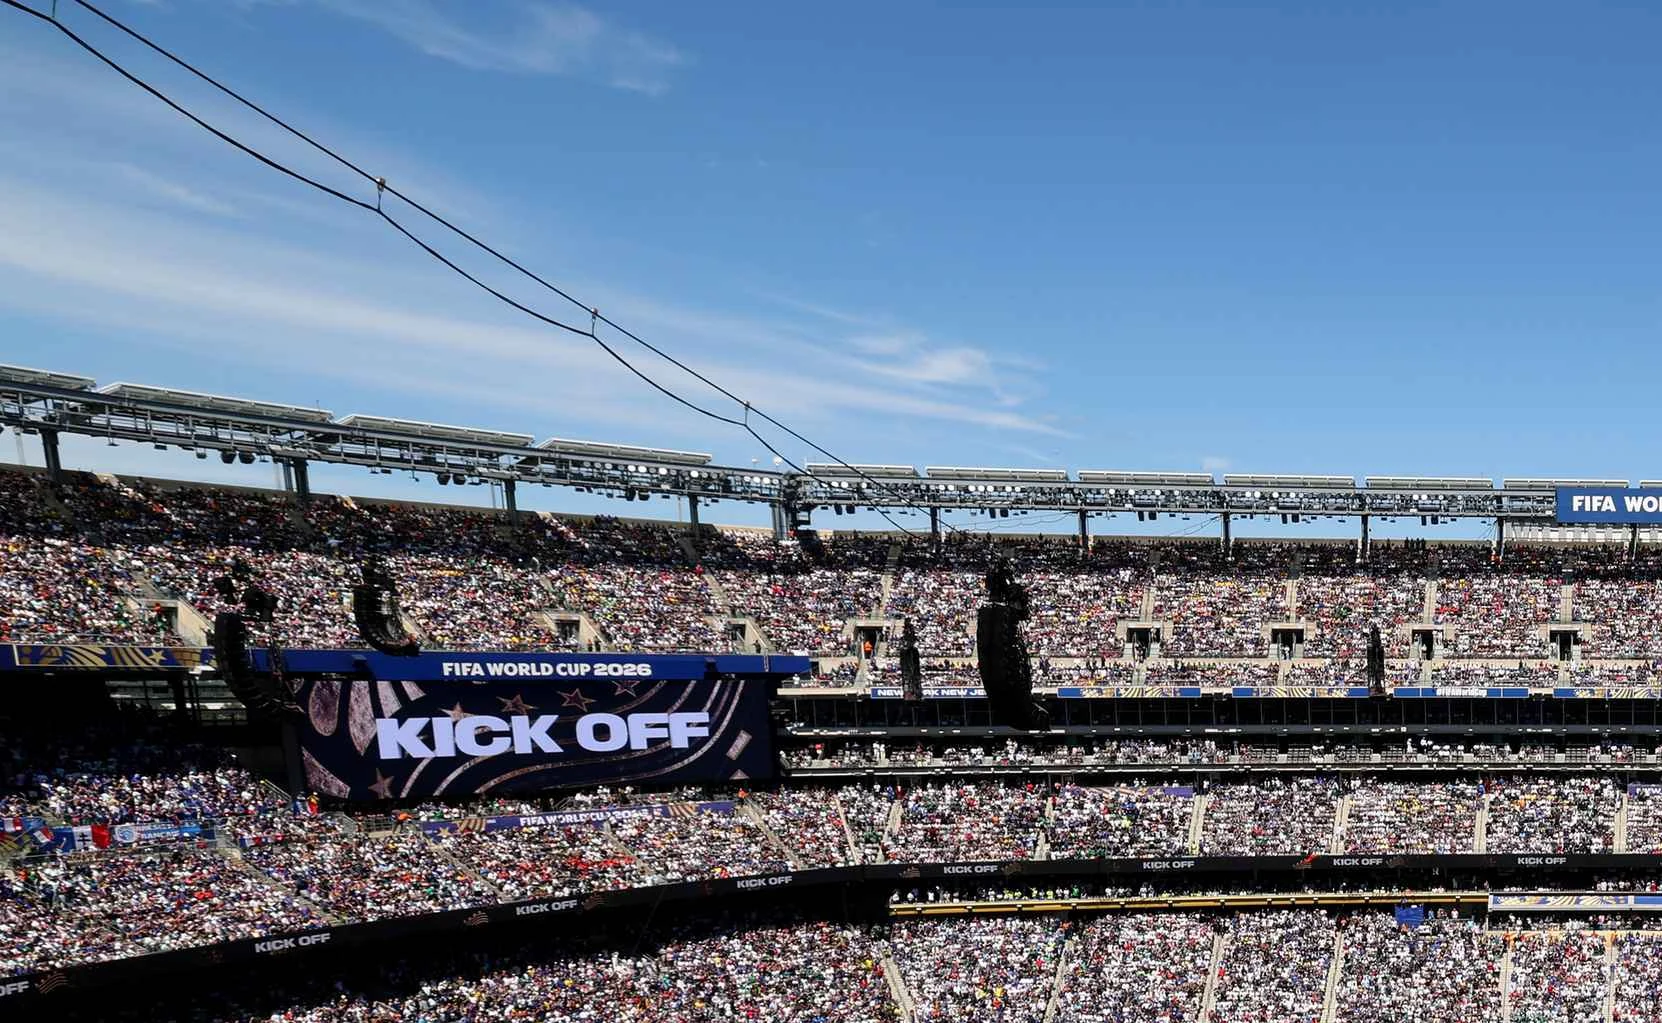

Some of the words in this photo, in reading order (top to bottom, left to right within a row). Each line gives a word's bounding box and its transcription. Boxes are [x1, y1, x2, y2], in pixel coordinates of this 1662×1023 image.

[1572, 495, 1616, 512] FIFA
[442, 663, 484, 676] FIFA
[487, 662, 554, 677] WORLD
[556, 662, 591, 677] CUP
[593, 663, 652, 677] 2026
[376, 714, 563, 760] KICK
[576, 712, 709, 752] OFF
[520, 816, 545, 826] FIFA
[1143, 861, 1171, 870] KICK
[1173, 860, 1195, 869] OFF
[1333, 858, 1360, 867] KICK
[1362, 858, 1383, 866] OFF
[1518, 857, 1543, 865] KICK
[1545, 857, 1566, 865] OFF
[943, 865, 973, 874] KICK
[974, 864, 998, 873] OFF
[736, 877, 767, 889] KICK
[769, 875, 793, 886] OFF
[515, 902, 550, 916] KICK
[552, 899, 577, 911] OFF
[254, 938, 296, 953] KICK
[298, 932, 331, 947] OFF
